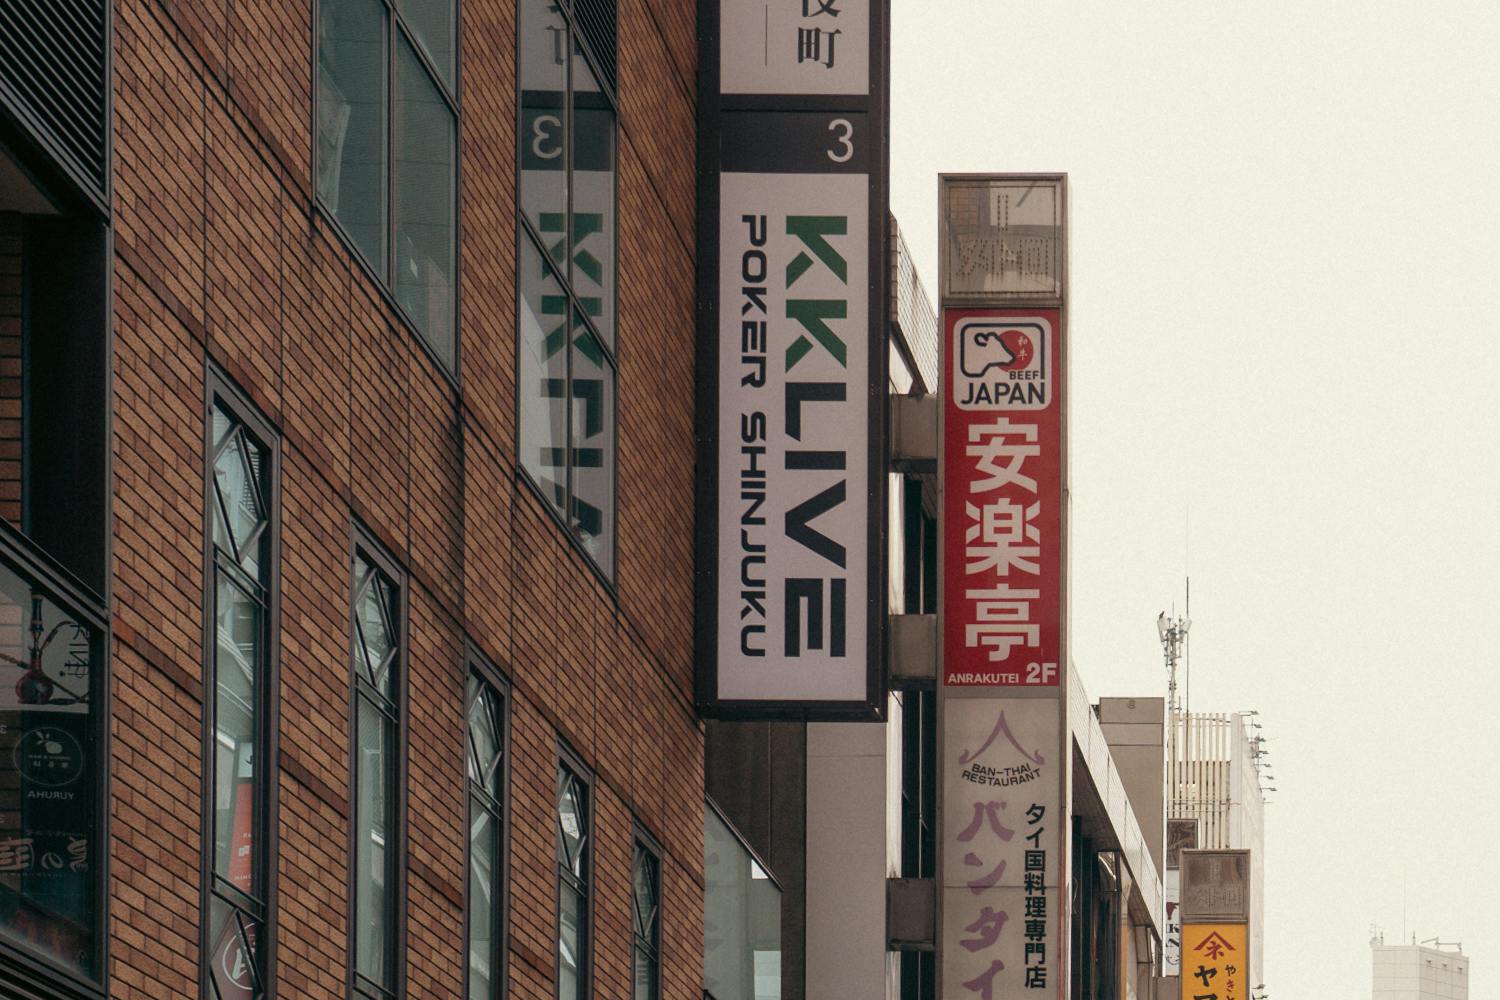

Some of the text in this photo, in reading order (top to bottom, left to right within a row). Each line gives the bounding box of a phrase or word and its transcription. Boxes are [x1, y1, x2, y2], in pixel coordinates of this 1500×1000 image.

[826, 119, 854, 162] 3
[960, 382, 1045, 405] JAPAN
[1009, 370, 1040, 380] BEEF
[740, 215, 767, 657] POKER SHINJUKU
[785, 215, 848, 657] KKLIVE
[965, 417, 1041, 662] 安楽亭
[948, 662, 1057, 684] ANRAKUTEI 2F
[961, 768, 1041, 787] RESTAURANT
[1024, 803, 1047, 989] タイ国料理専門店
